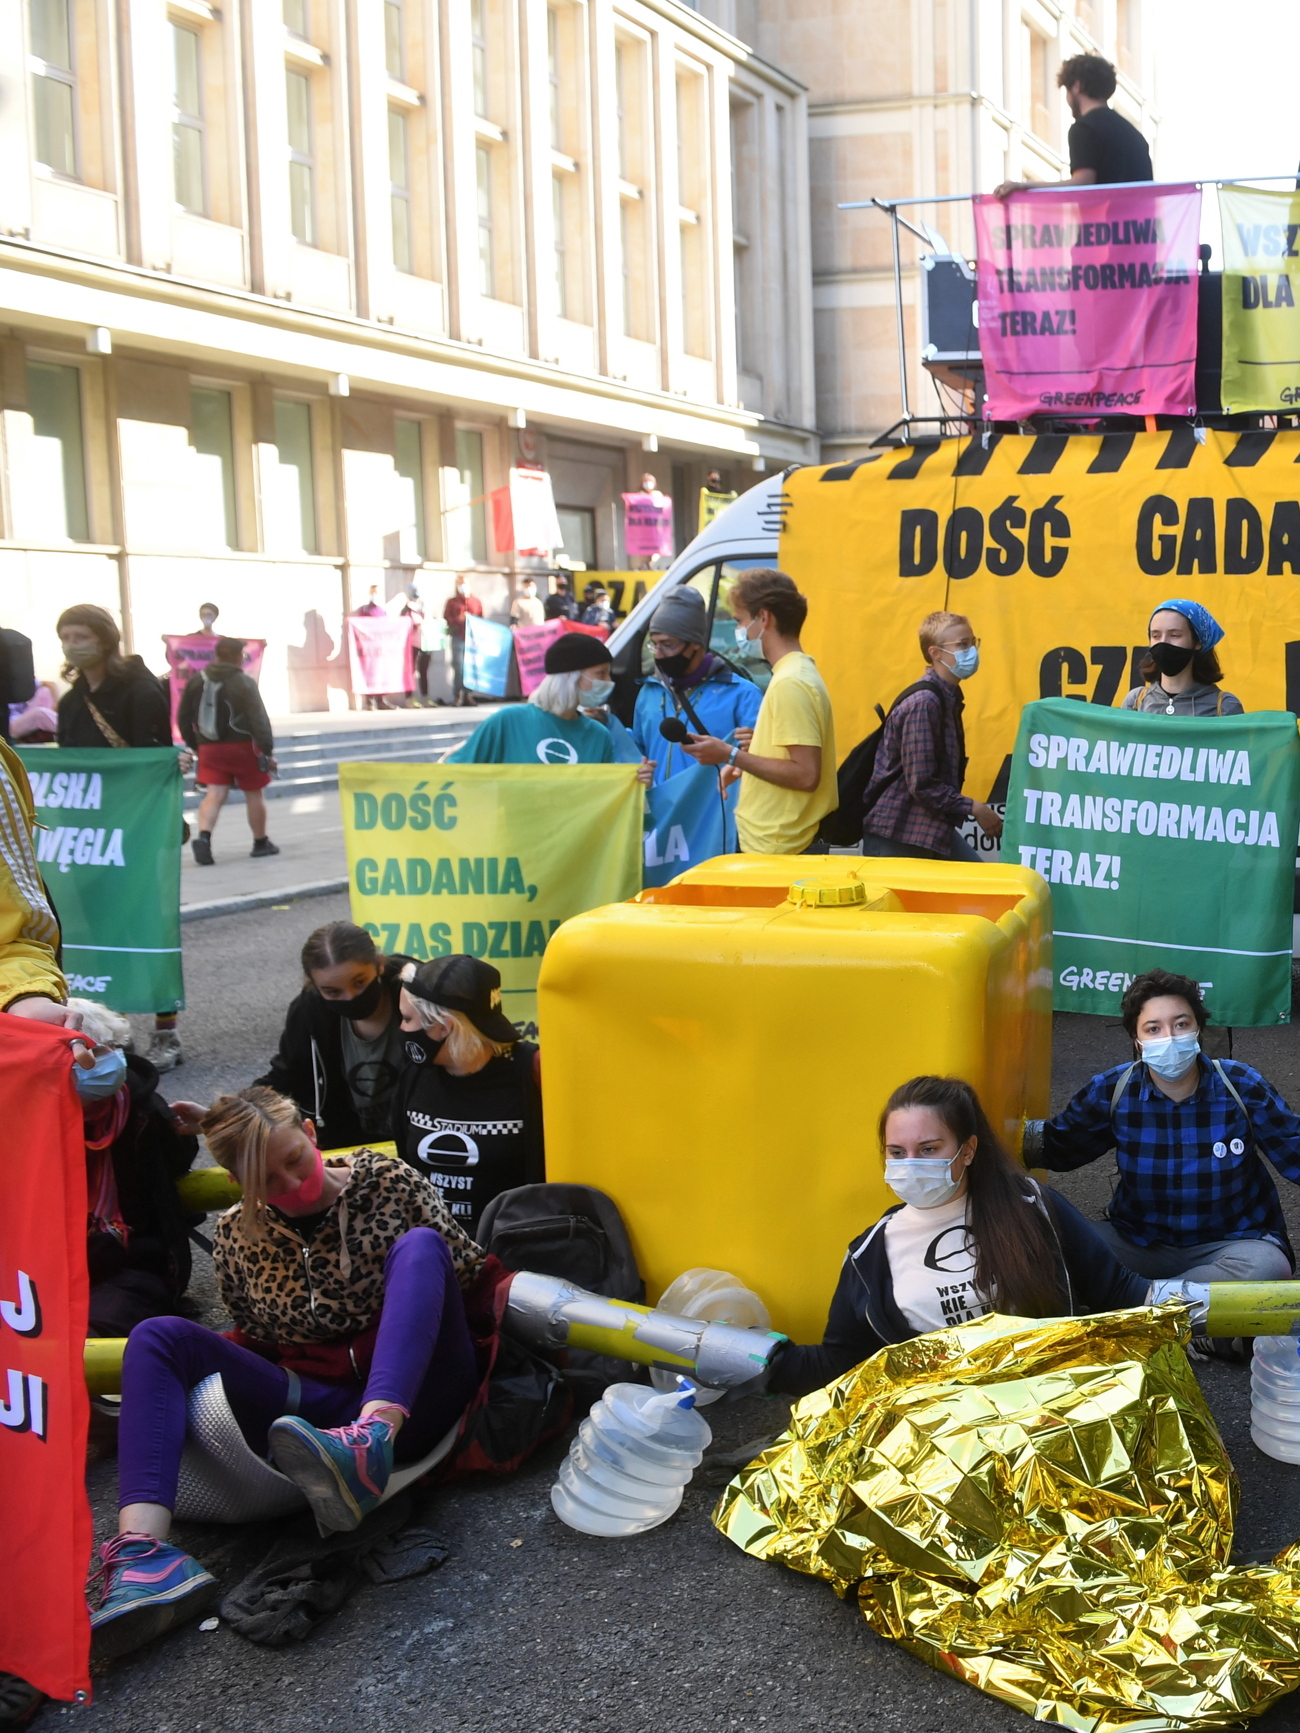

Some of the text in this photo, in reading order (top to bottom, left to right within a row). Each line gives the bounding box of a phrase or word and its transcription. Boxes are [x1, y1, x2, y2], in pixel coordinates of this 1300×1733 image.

[992, 217, 1166, 250] SPRAWIEDLIWA
[996, 258, 1190, 293] TRANSFORMACJA
[1241, 273, 1295, 310] DLA
[998, 308, 1077, 337] TERAZ!
[1039, 389, 1146, 408] GREENPEACE
[898, 494, 1071, 580] DOŚĆ
[1028, 733, 1251, 786] SPRAWIEDLIWA
[354, 781, 458, 830] DOŚĆ
[1023, 789, 1281, 848] TRANSFORMACJA
[37, 826, 125, 873] WĘGLA
[1018, 845, 1121, 890] TERAZ!
[356, 856, 539, 902] GADANIA,
[434, 1118, 482, 1135] STADIUM
[430, 1171, 473, 1190] WSZYST
[940, 1295, 968, 1316] KIE
